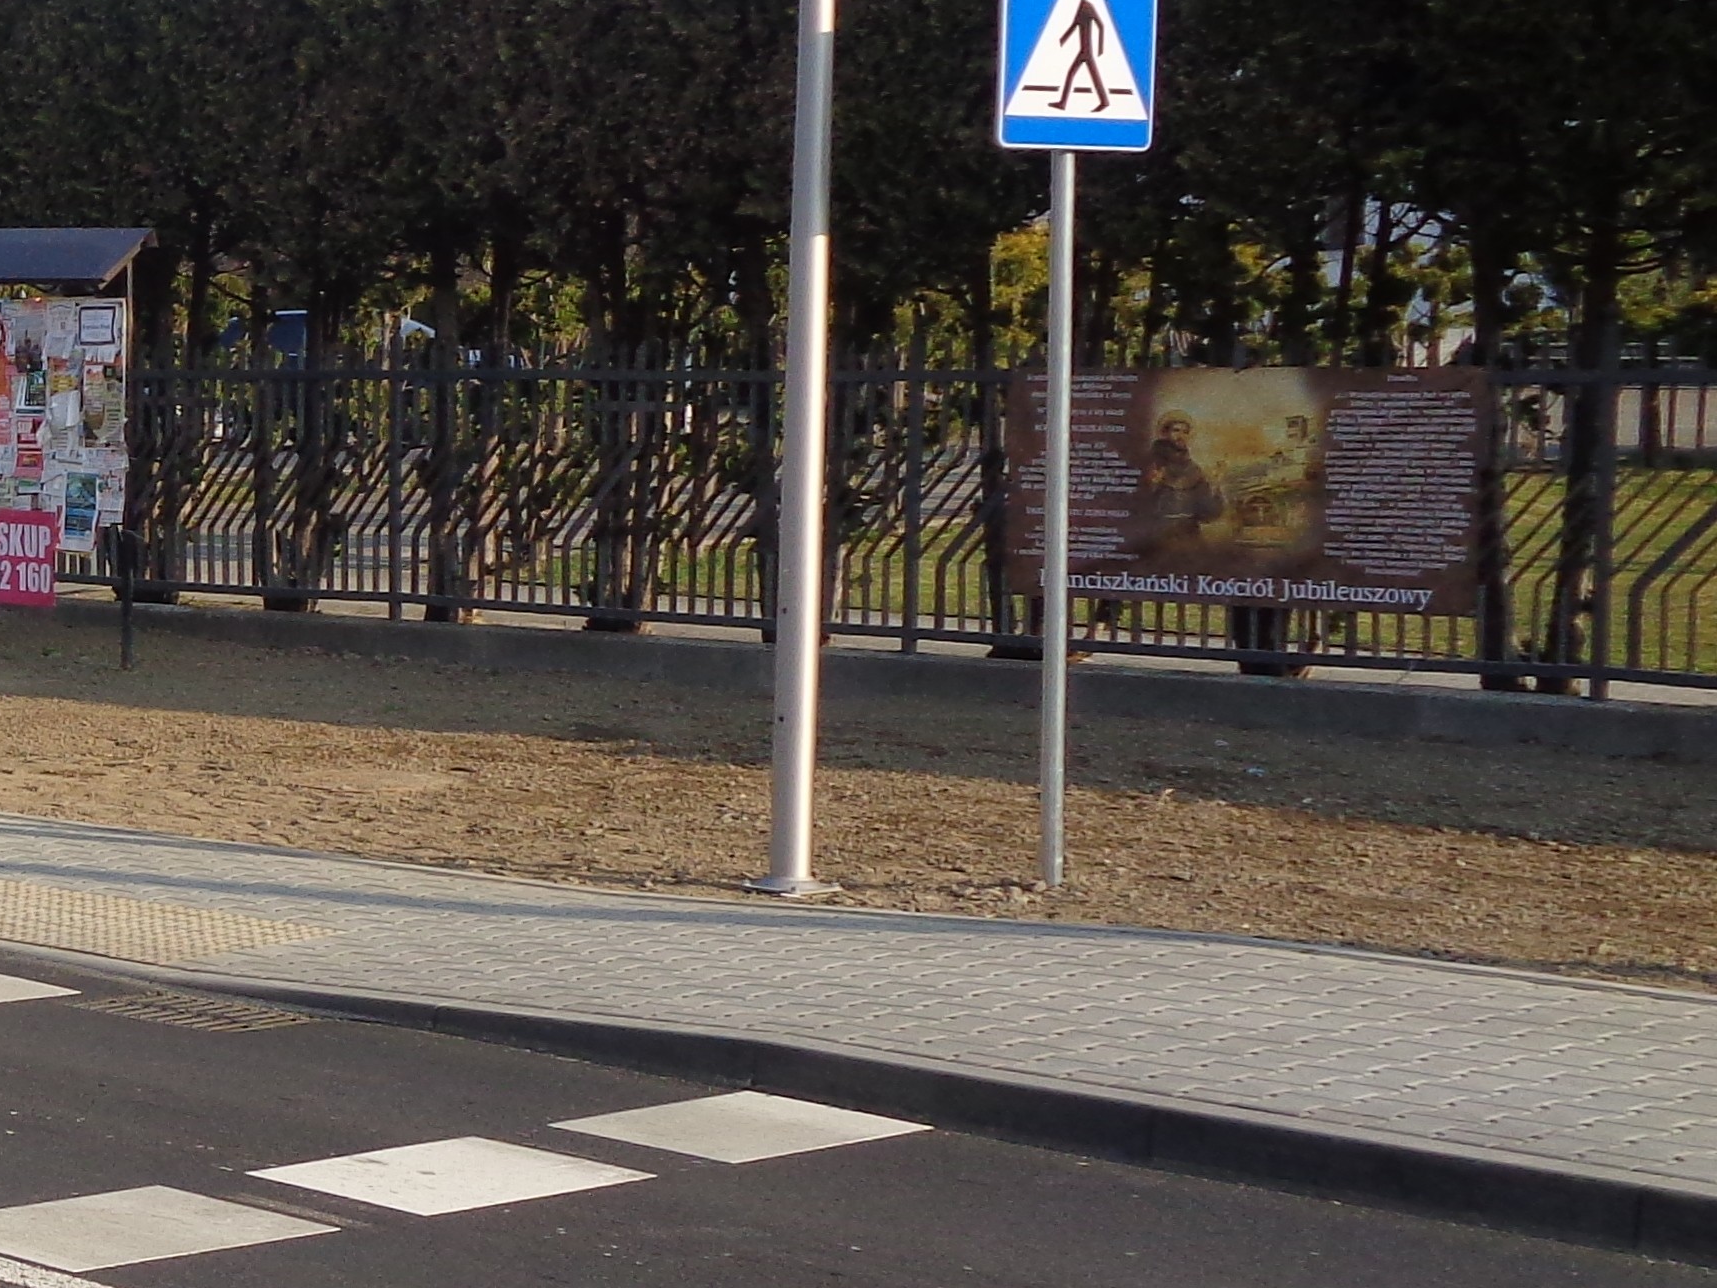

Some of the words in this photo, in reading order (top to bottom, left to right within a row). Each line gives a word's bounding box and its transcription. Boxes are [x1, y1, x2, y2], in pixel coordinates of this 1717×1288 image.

[16, 561, 51, 593] 160
[1039, 568, 1189, 594] nciszkański
[1196, 574, 1274, 597] Kościół
[1279, 579, 1433, 611] Jubileuszowy
